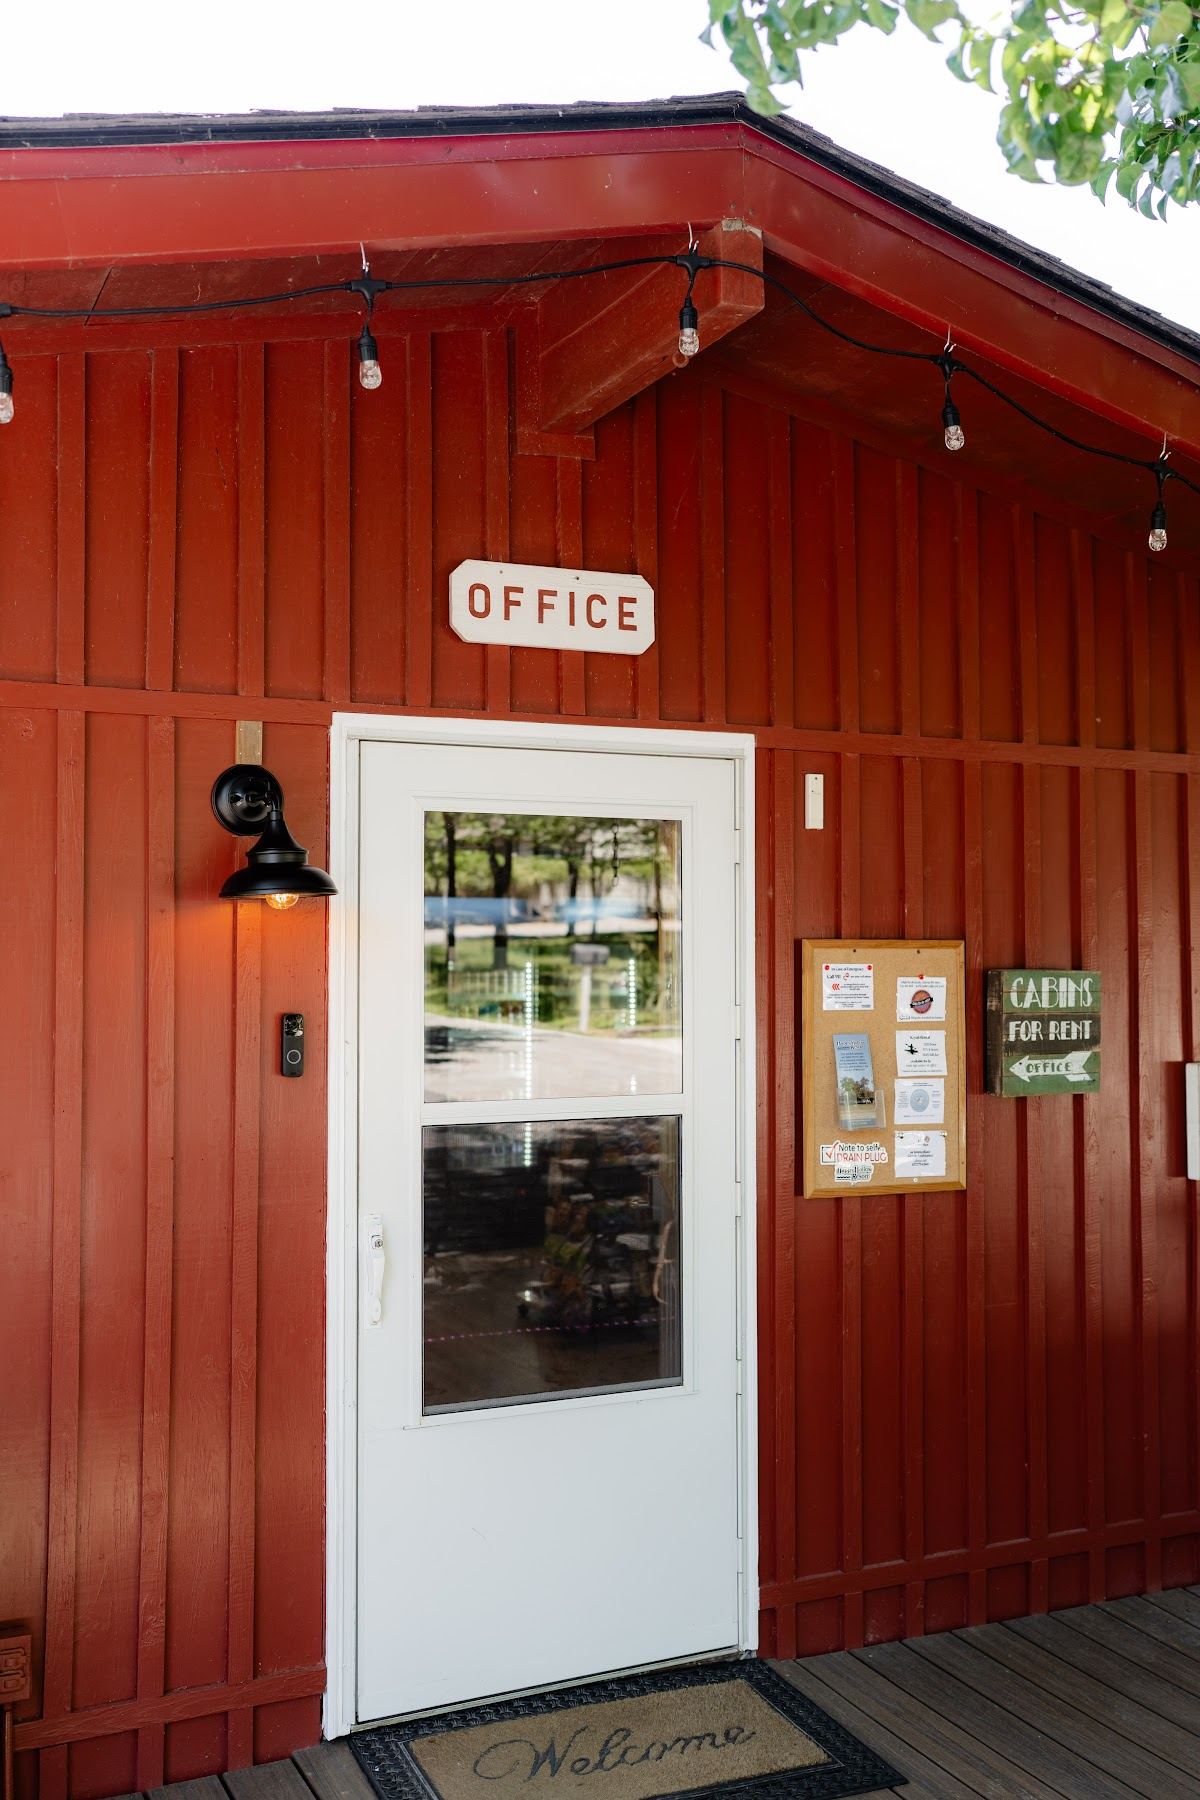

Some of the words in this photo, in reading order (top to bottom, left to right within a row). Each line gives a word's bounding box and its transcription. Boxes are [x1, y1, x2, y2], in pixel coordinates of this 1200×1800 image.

[468, 582, 638, 632] OFFICE
[1009, 976, 1093, 1009] CABINS
[1008, 1020, 1044, 1042] FOR
[1049, 1020, 1093, 1041] RENT
[1025, 1062, 1073, 1073] OFFICE
[836, 1152, 862, 1162] DRAIN
[864, 1152, 887, 1162] PLUG
[473, 1724, 758, 1783] Welcome
